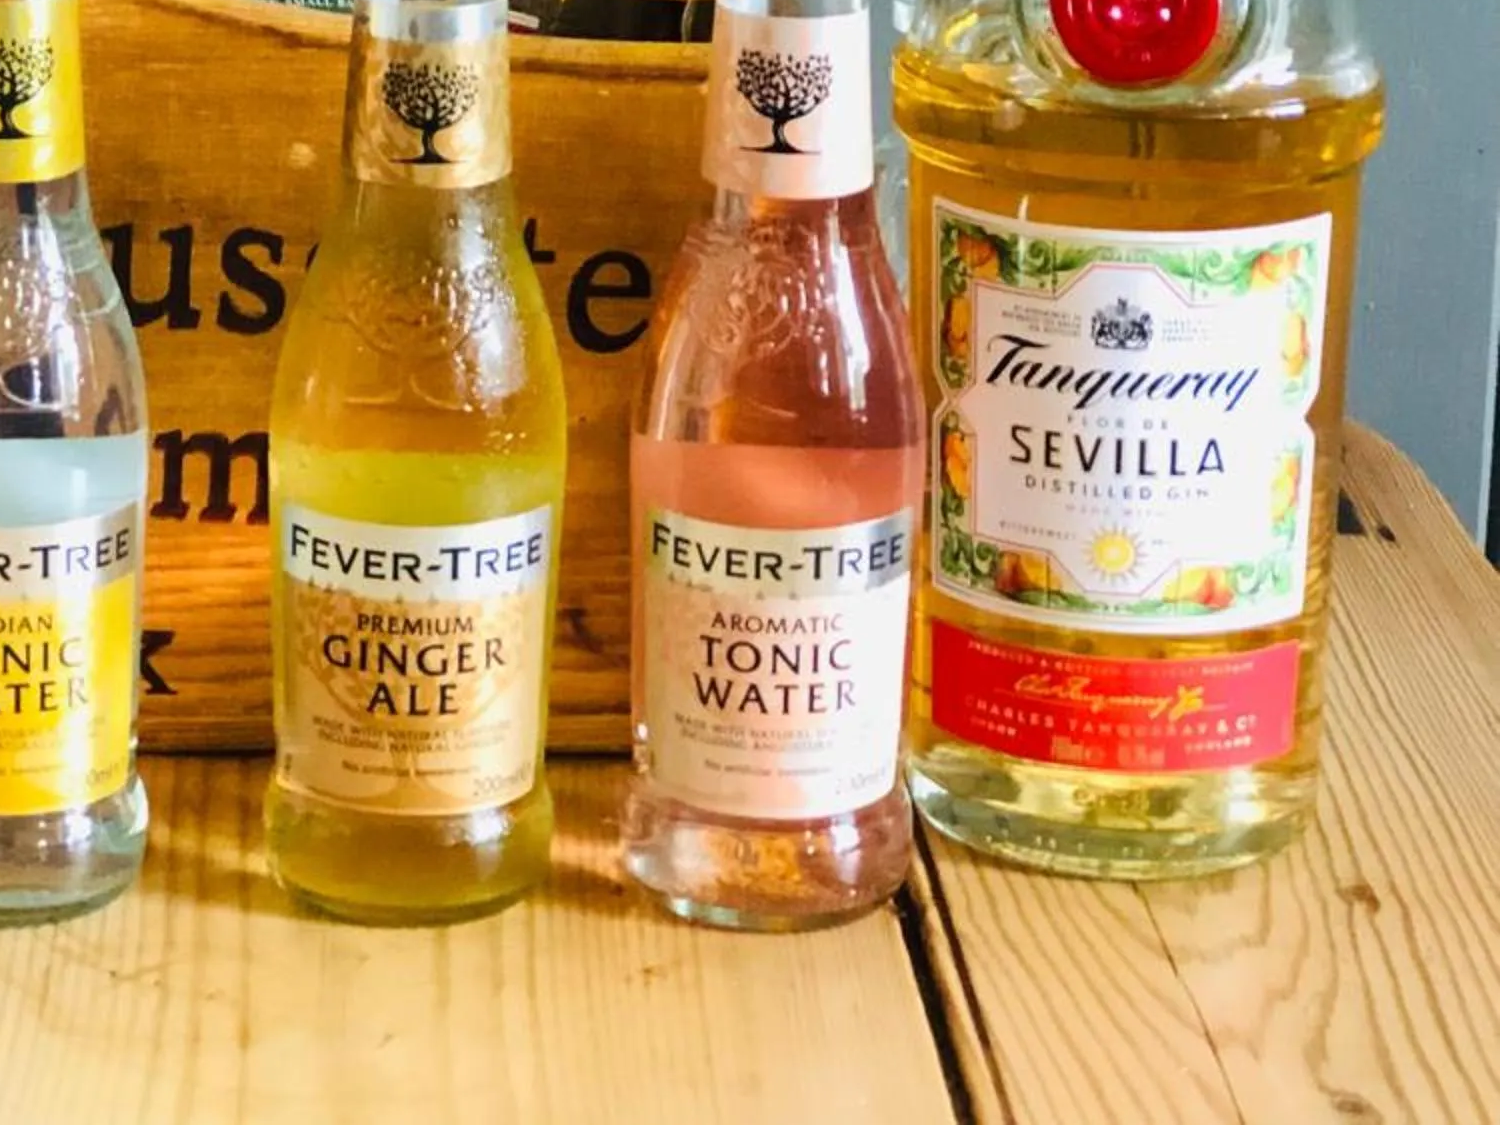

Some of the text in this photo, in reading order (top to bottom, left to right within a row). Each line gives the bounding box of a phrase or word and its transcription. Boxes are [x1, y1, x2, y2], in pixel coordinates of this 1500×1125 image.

[986, 334, 1260, 412] Tanqueray
[1009, 424, 1225, 476] SEVILLA
[1025, 474, 1210, 500] DISTILLED GIN
[290, 522, 543, 583] FEVER-TREE
[651, 522, 905, 582] FEVER-TREE
[356, 613, 475, 636] PREMIUM
[710, 611, 845, 635] AROMATIC
[322, 633, 507, 678] GINGER
[699, 634, 852, 676] TONIC
[366, 682, 461, 717] ALE
[692, 671, 857, 716] WATER
[964, 693, 1054, 729] CHARLES
